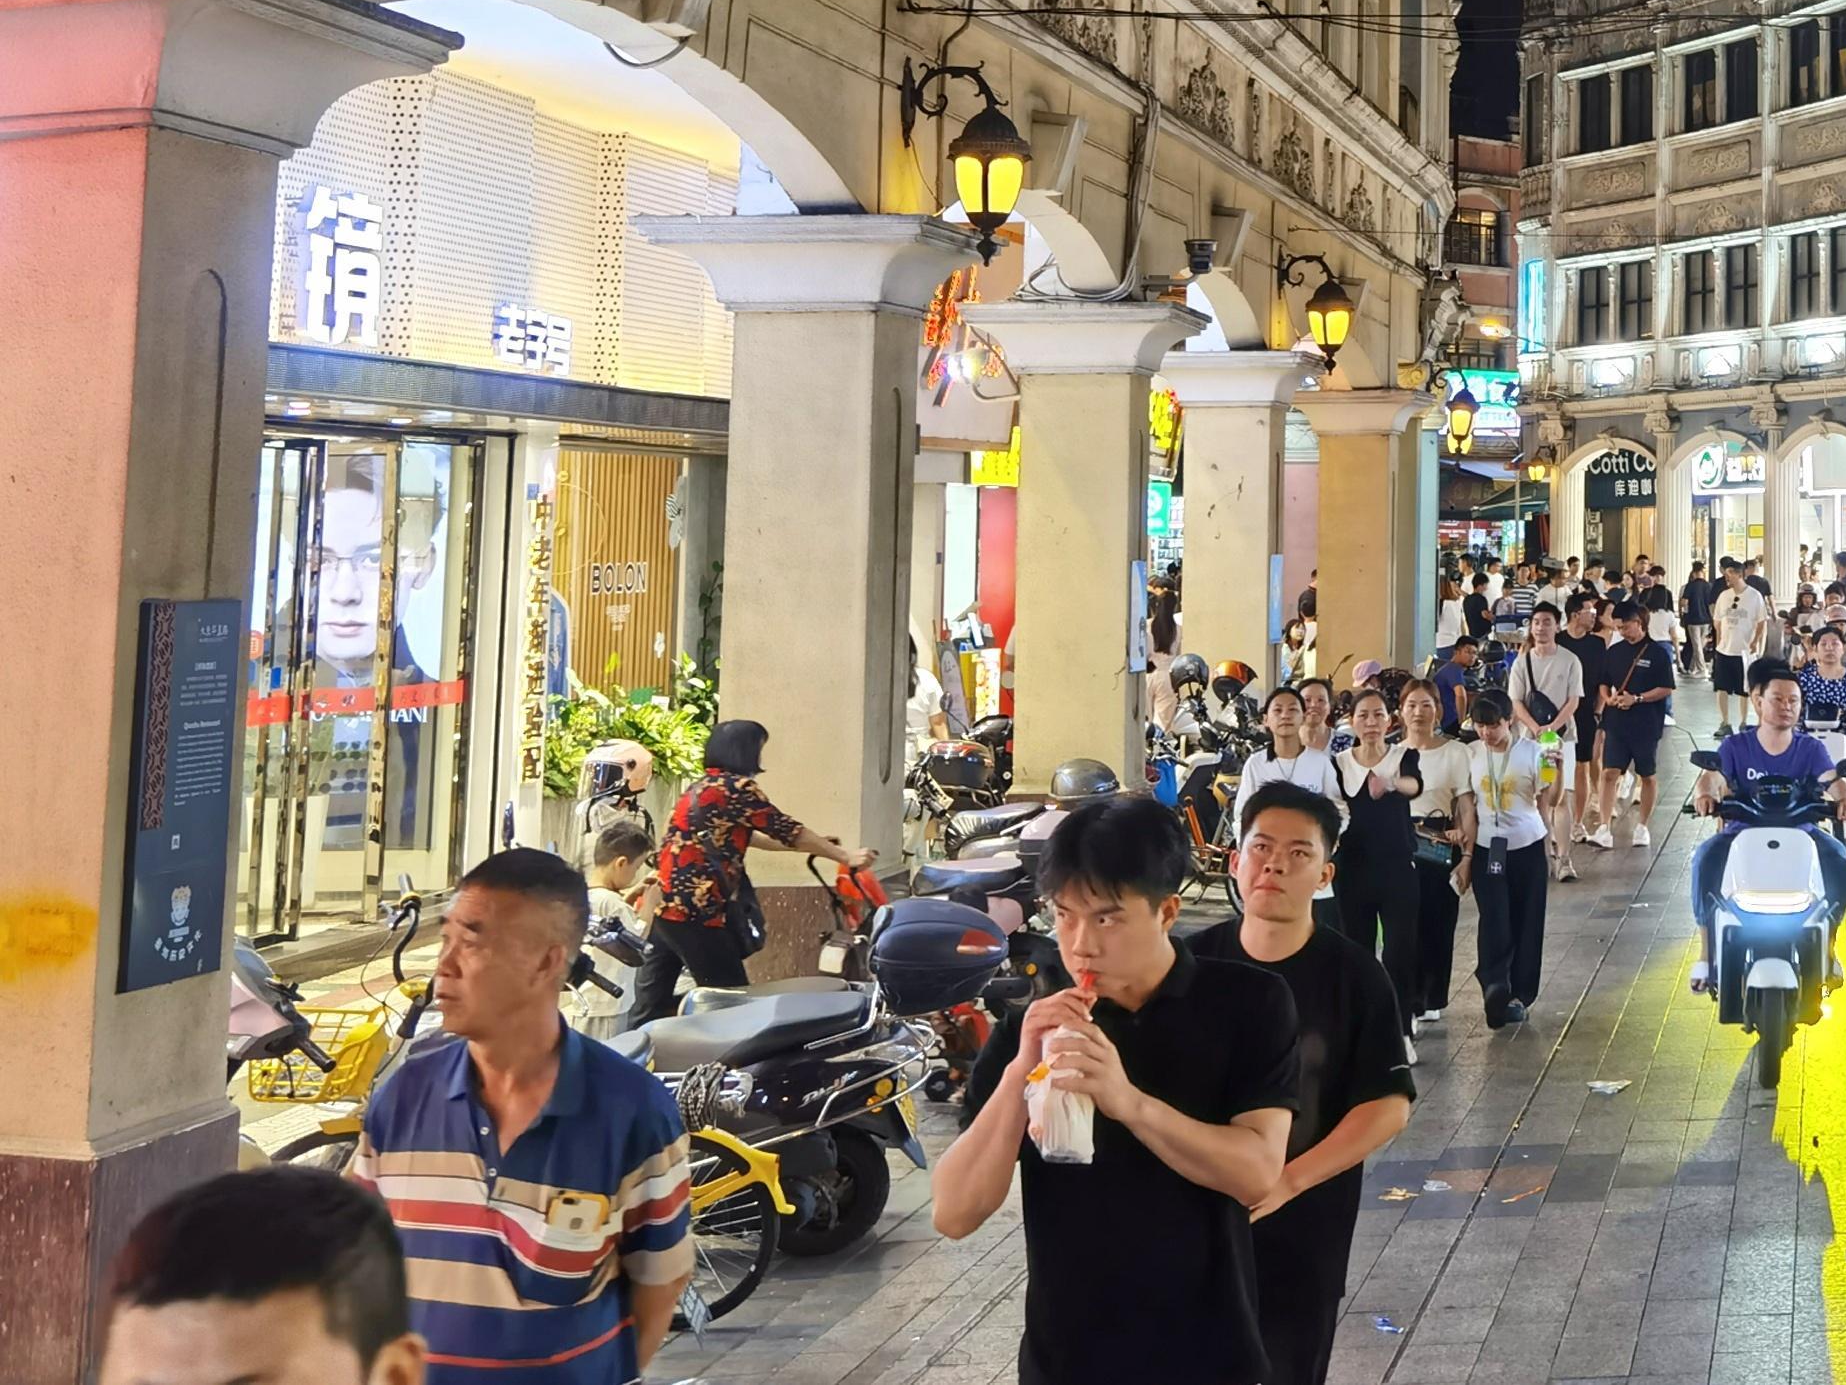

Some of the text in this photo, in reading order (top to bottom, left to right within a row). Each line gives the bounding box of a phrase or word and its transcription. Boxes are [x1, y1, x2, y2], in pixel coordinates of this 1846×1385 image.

[1590, 452, 1630, 474] Cotti
[1614, 478, 1657, 497] 库迪咖
[591, 562, 648, 595] BOLON
